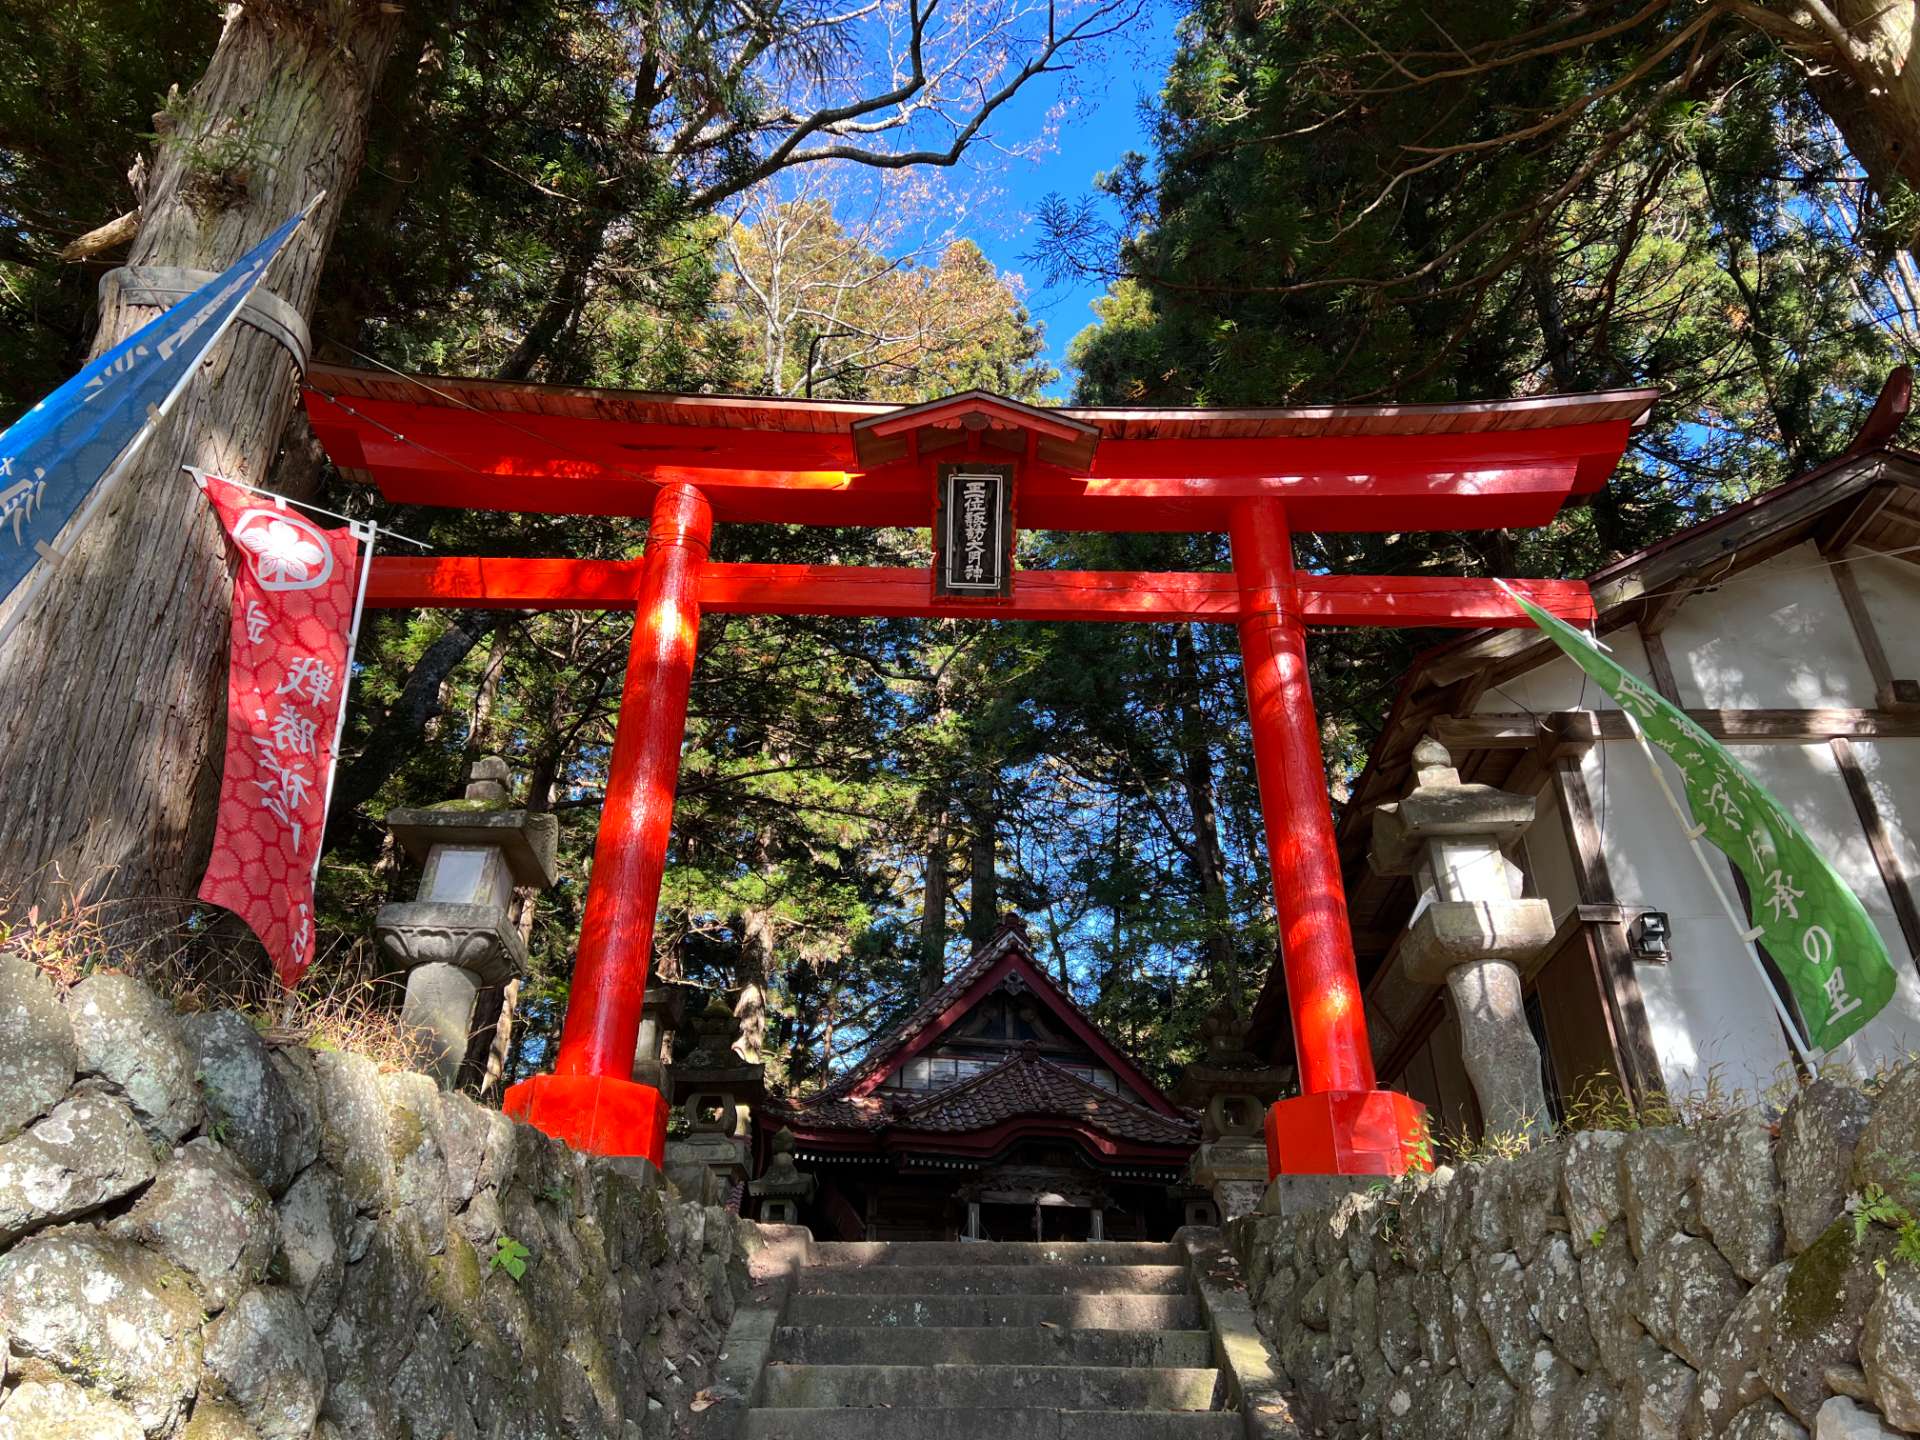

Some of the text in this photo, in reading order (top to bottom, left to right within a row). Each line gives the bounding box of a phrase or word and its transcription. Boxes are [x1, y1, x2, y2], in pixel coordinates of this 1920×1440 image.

[963, 481, 989, 584] 正一位諏訪大明神
